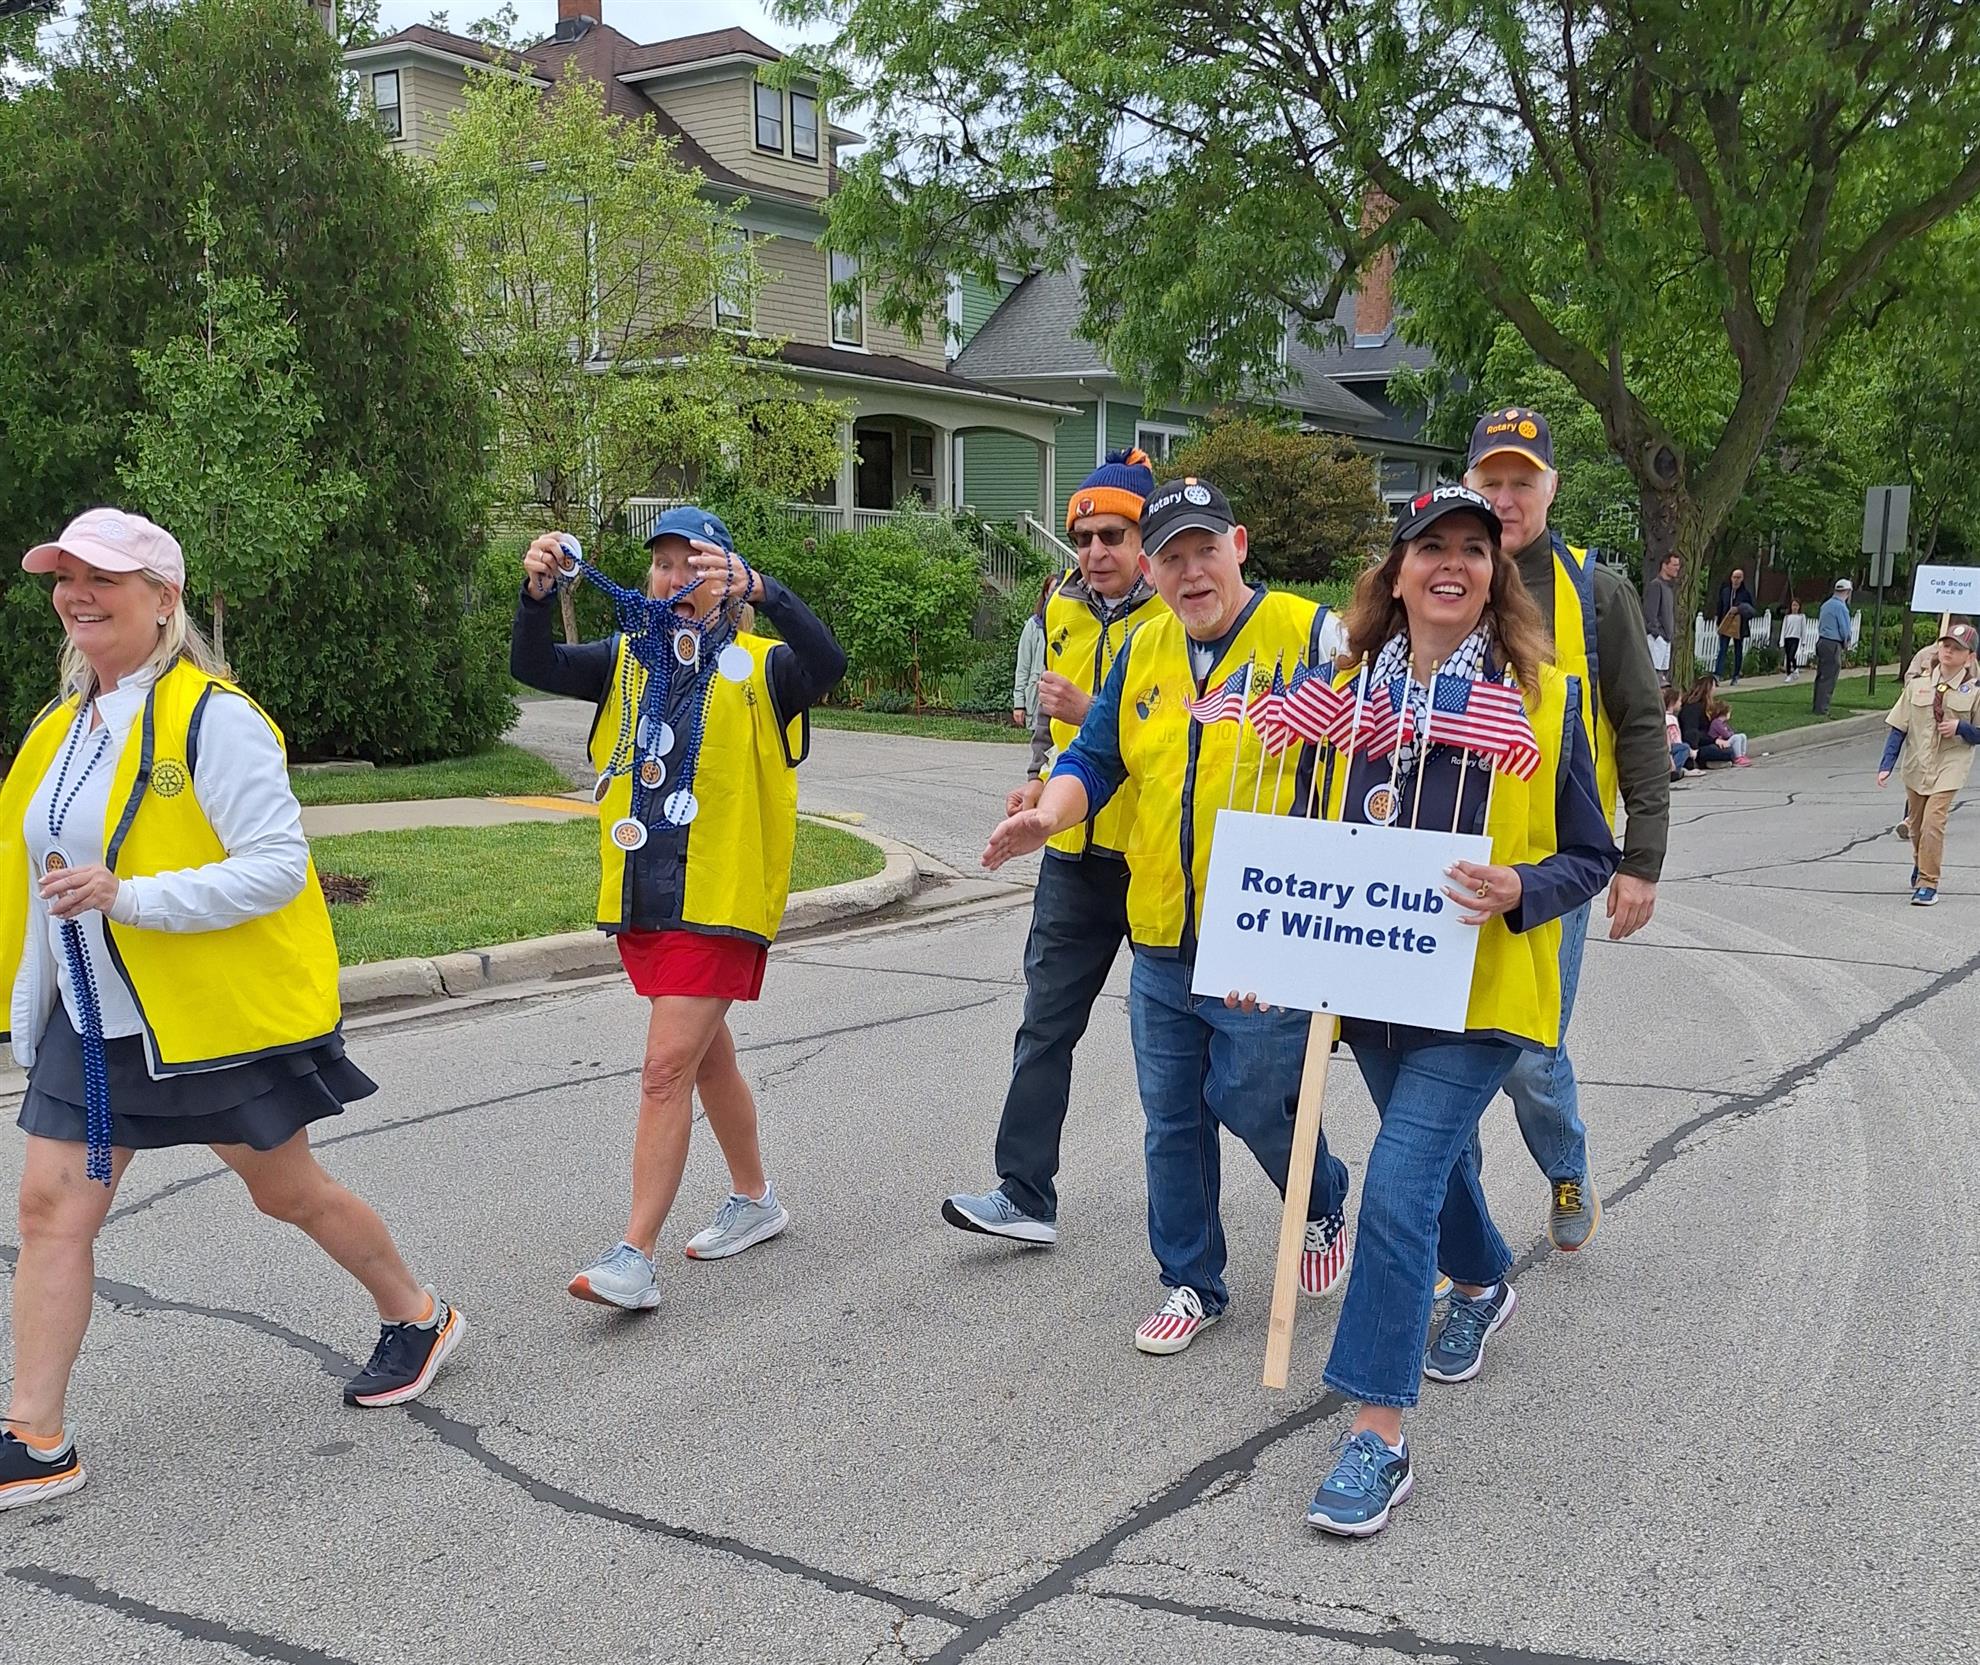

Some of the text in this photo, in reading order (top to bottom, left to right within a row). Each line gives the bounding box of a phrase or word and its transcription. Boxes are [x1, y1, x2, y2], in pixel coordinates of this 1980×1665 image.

[1486, 423, 1517, 435] Rotary
[1148, 491, 1182, 517] Rotary
[1948, 580, 1972, 588] Scout
[1450, 756, 1477, 768] Rory
[1241, 867, 1444, 914] Rotary Club
[1236, 908, 1437, 954] of Wilmette
